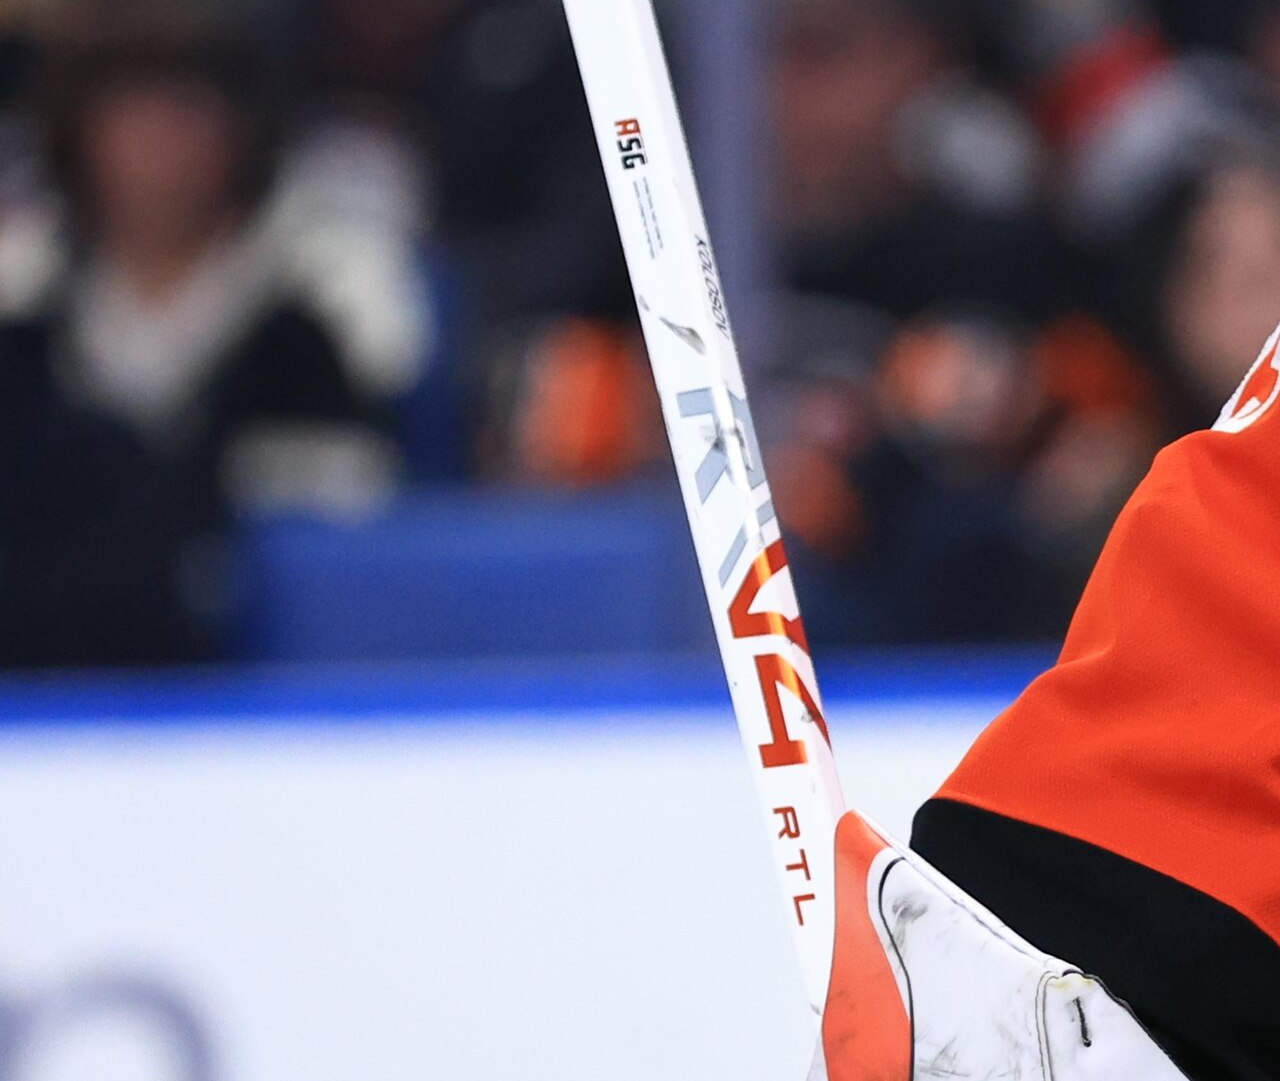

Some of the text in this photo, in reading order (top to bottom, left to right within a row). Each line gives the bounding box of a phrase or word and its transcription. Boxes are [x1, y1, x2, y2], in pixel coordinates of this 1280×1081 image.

[613, 118, 648, 171] ASG
[693, 232, 731, 341] KOLOSOV
[772, 805, 817, 927] RTL
